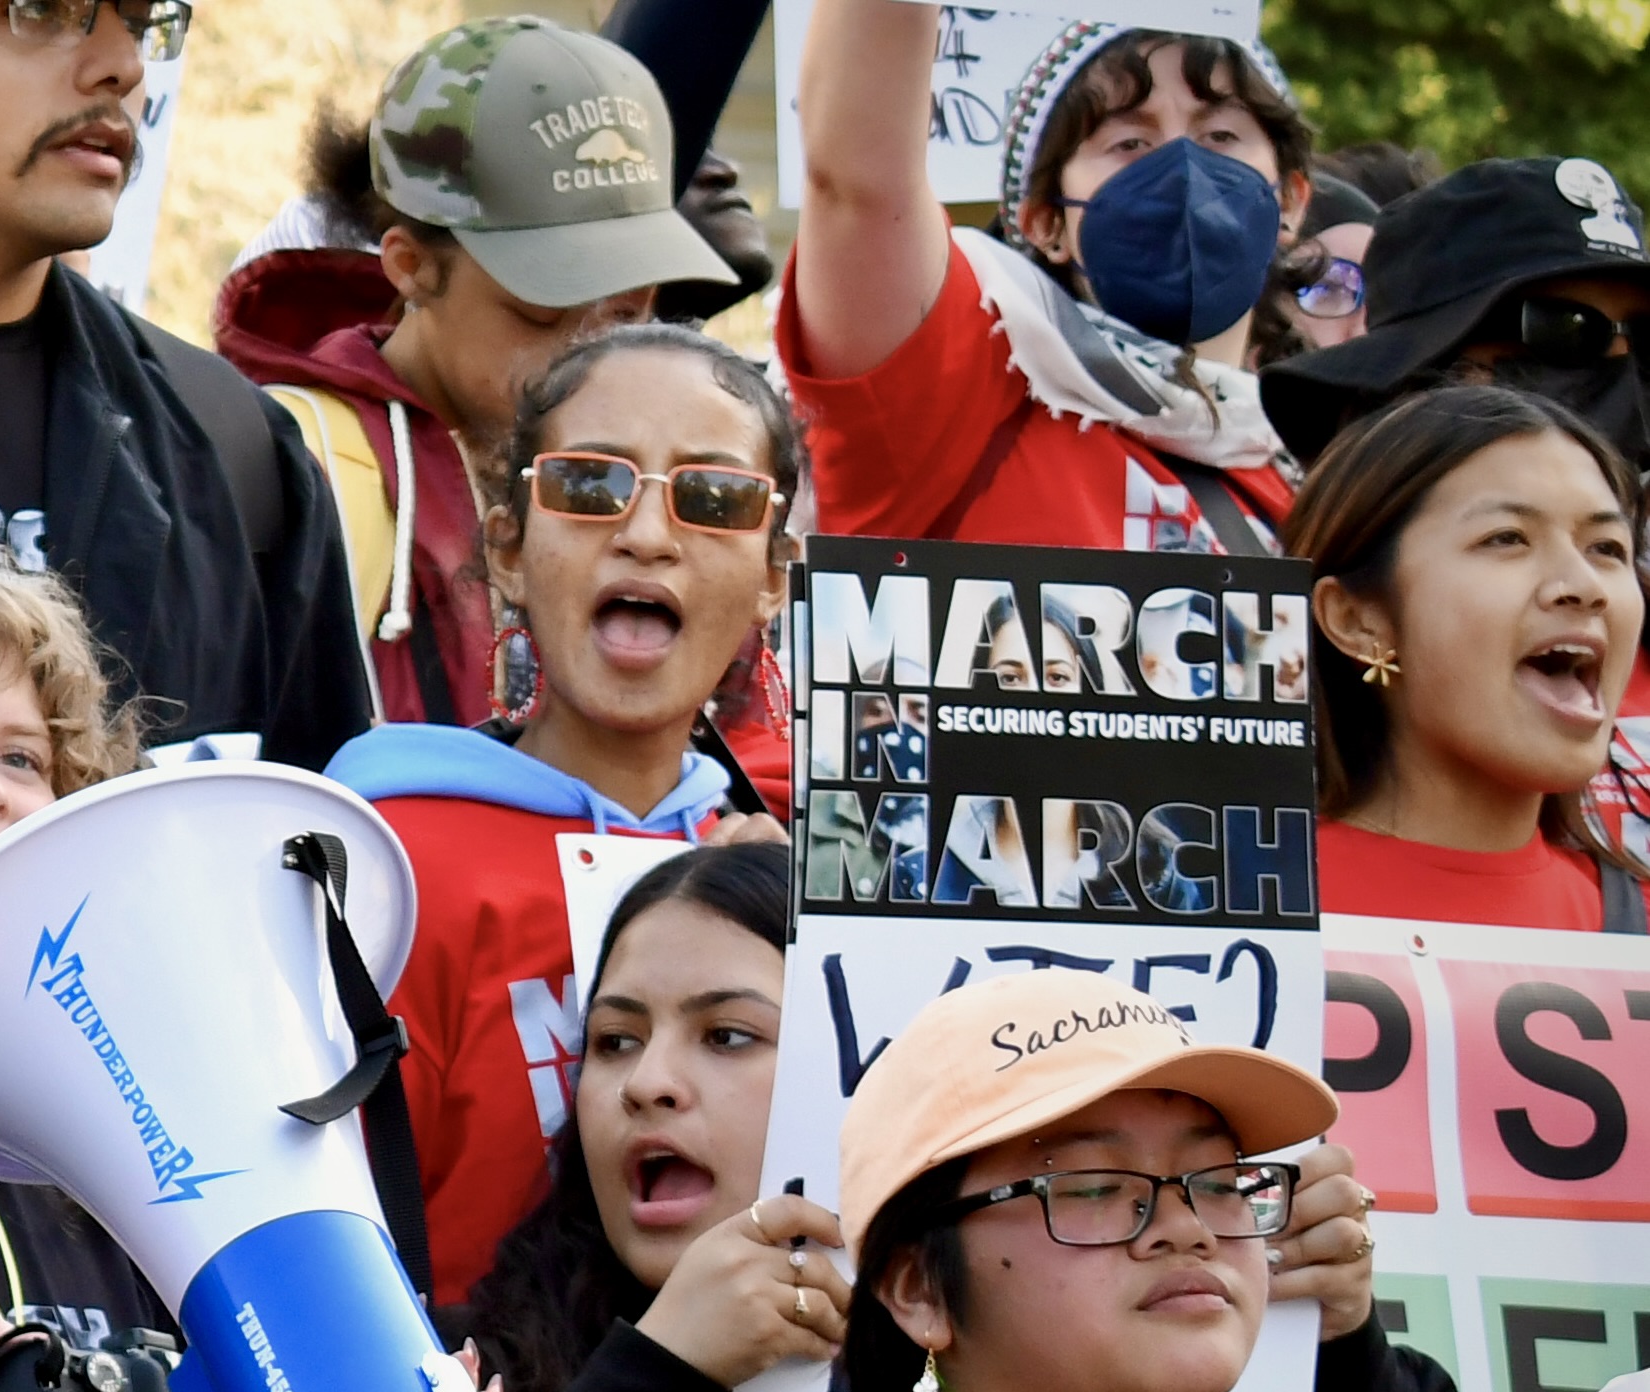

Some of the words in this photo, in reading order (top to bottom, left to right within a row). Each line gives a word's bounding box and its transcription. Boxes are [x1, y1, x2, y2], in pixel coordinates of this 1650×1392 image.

[528, 95, 616, 150] TRADE
[810, 570, 1310, 706] MARCH
[809, 688, 931, 784] IN
[937, 703, 1066, 737] SECURING
[1068, 709, 1207, 743] STUDENTS'
[1210, 716, 1306, 748] FUTURE
[804, 789, 1316, 918] MARCH
[39, 951, 195, 1193] THUNDERPOWER
